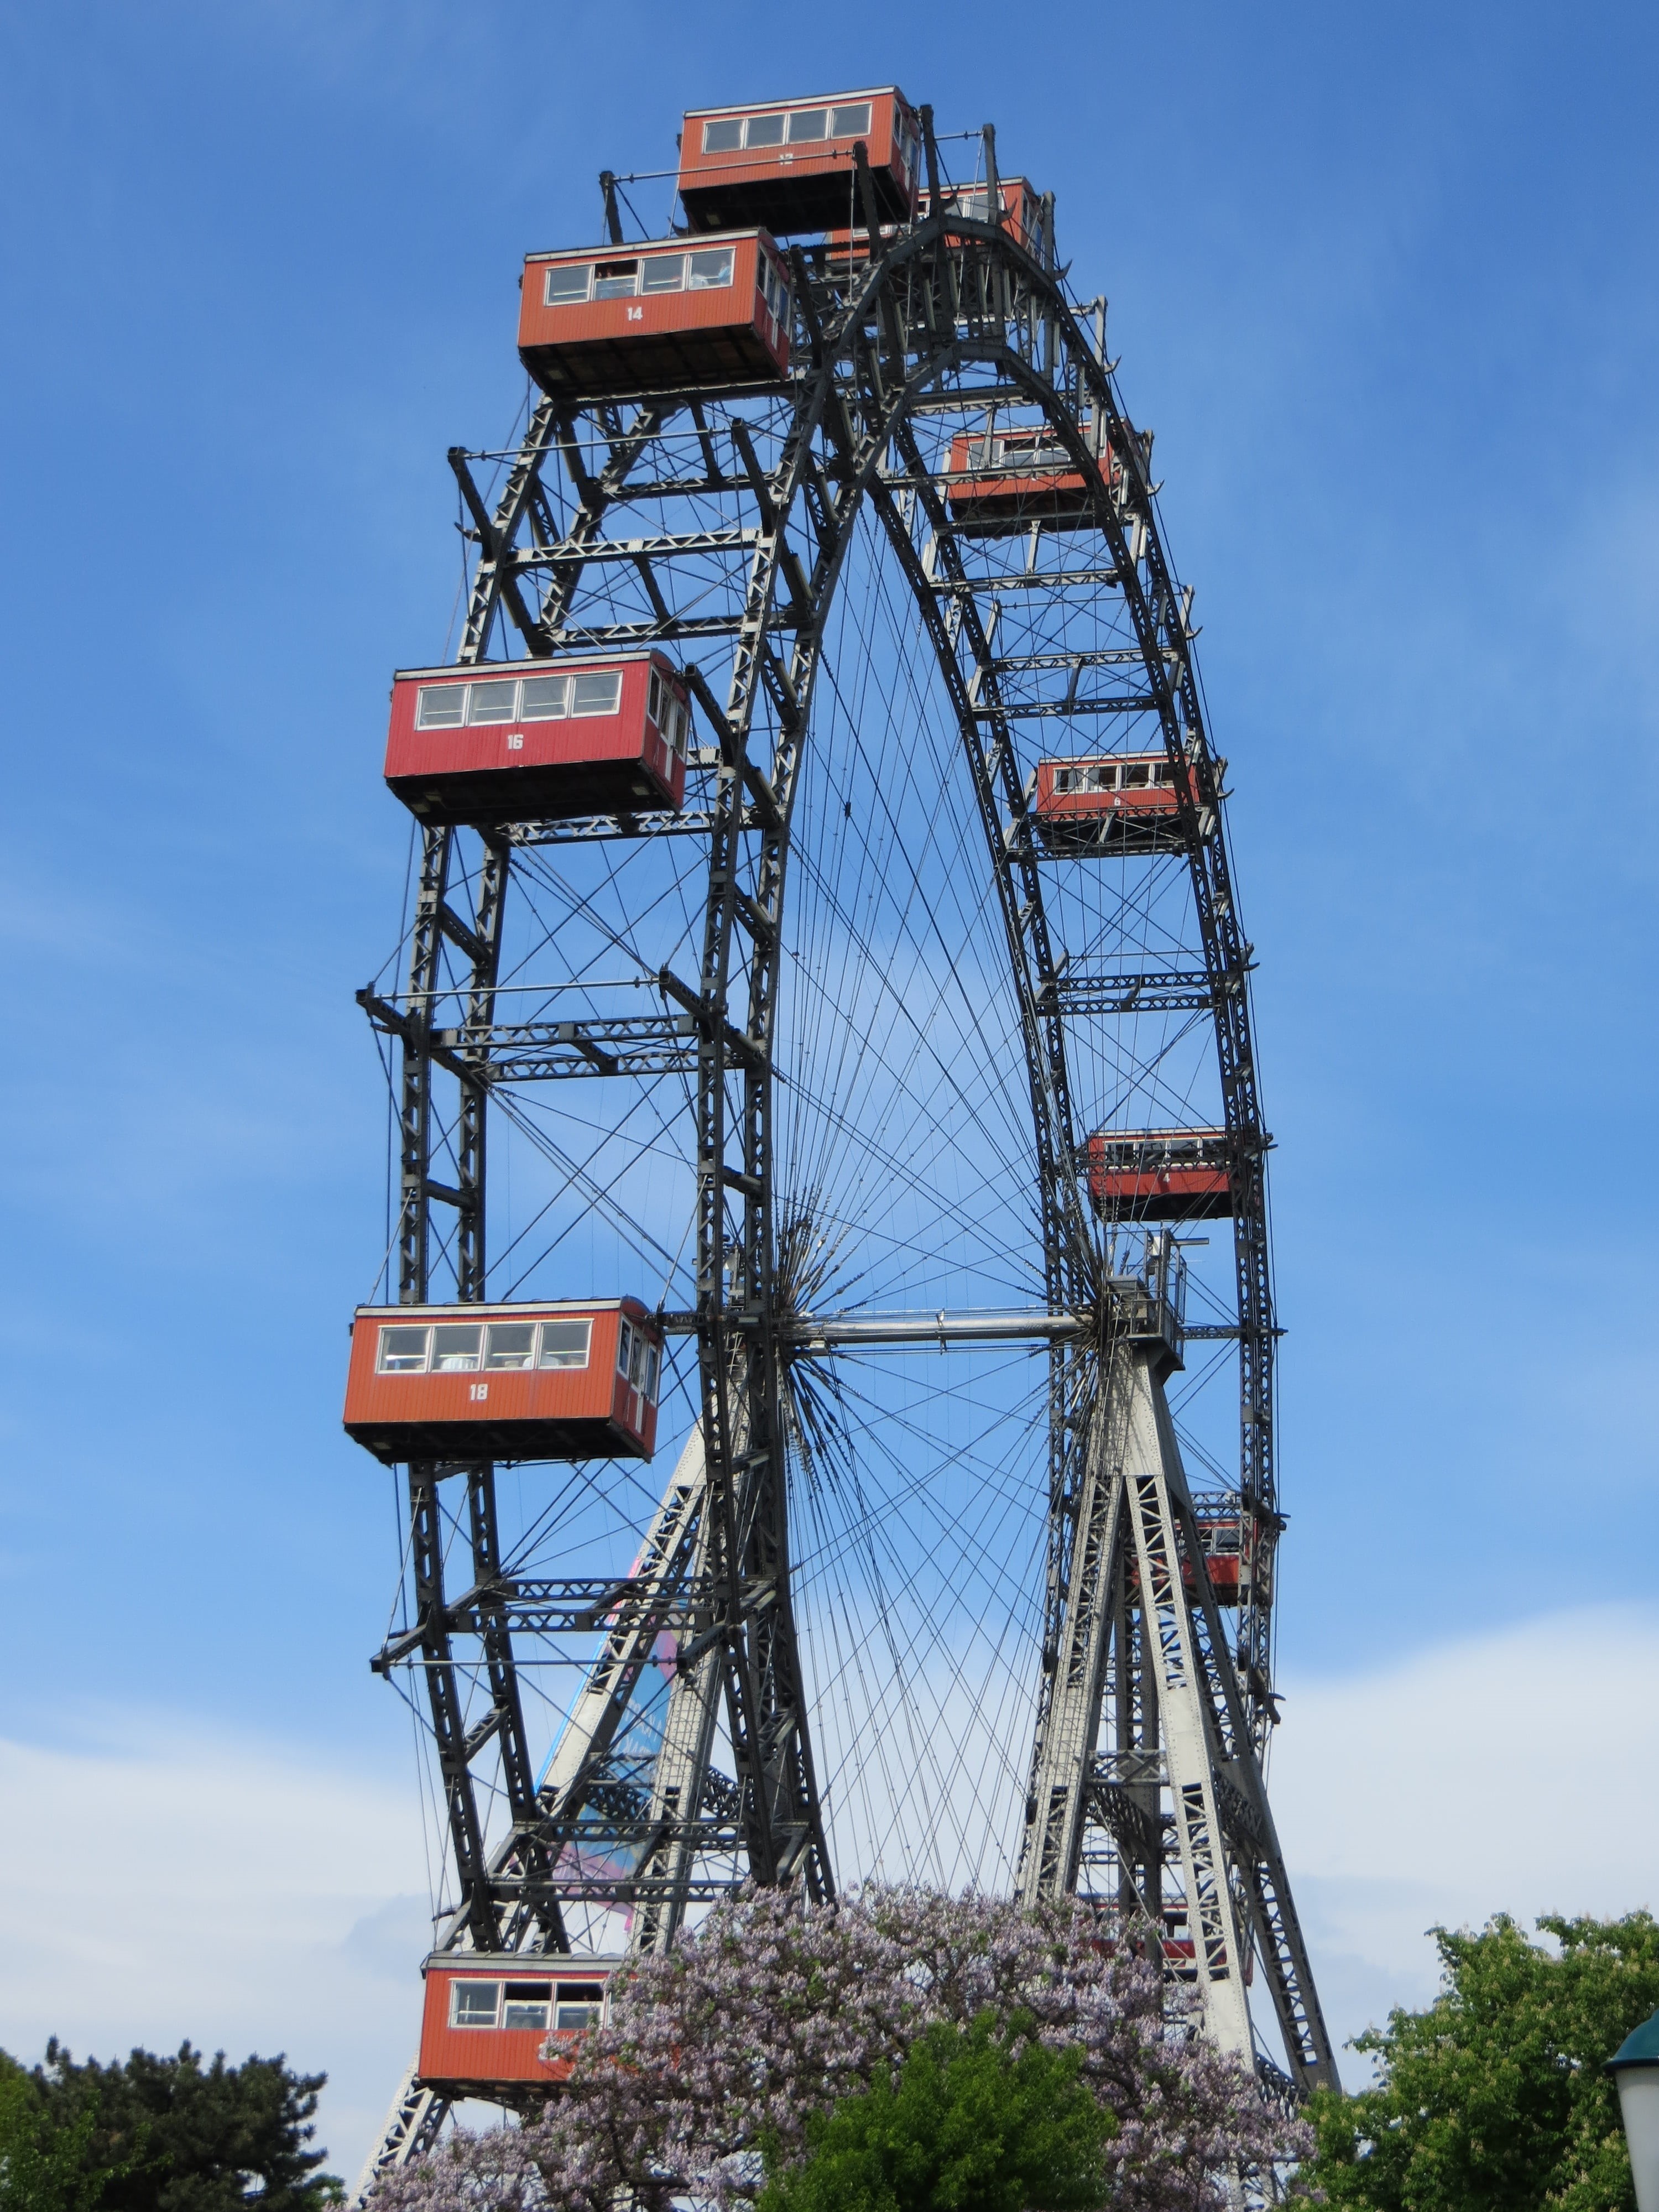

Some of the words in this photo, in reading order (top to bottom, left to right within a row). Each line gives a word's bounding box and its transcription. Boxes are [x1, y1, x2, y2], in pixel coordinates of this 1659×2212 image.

[779, 153, 793, 165] 12
[628, 306, 643, 321] 14
[508, 734, 524, 749] 16
[1114, 796, 1121, 806] 6
[1163, 1172, 1170, 1182] 4
[470, 1383, 488, 1400] 18
